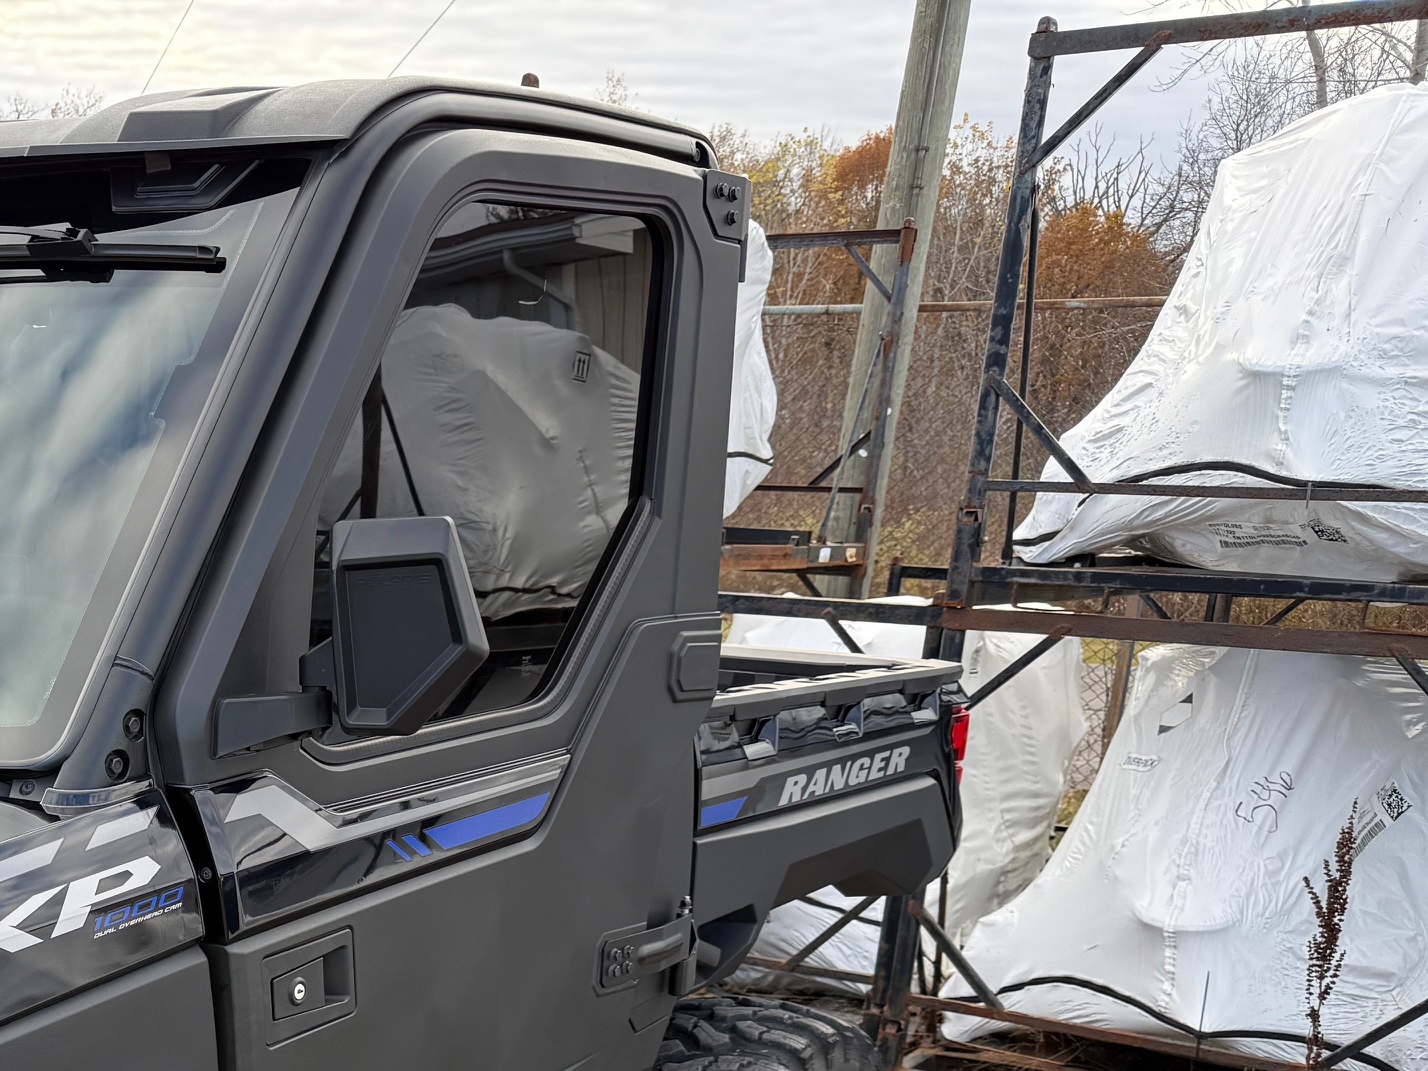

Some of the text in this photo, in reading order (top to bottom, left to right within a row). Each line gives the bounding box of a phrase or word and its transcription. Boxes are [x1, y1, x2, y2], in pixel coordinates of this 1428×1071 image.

[777, 745, 911, 807] RANGER
[1234, 770, 1295, 834] 546
[93, 885, 185, 932] 1000
[93, 902, 183, 940] DUAL OVERHEAD CAM
